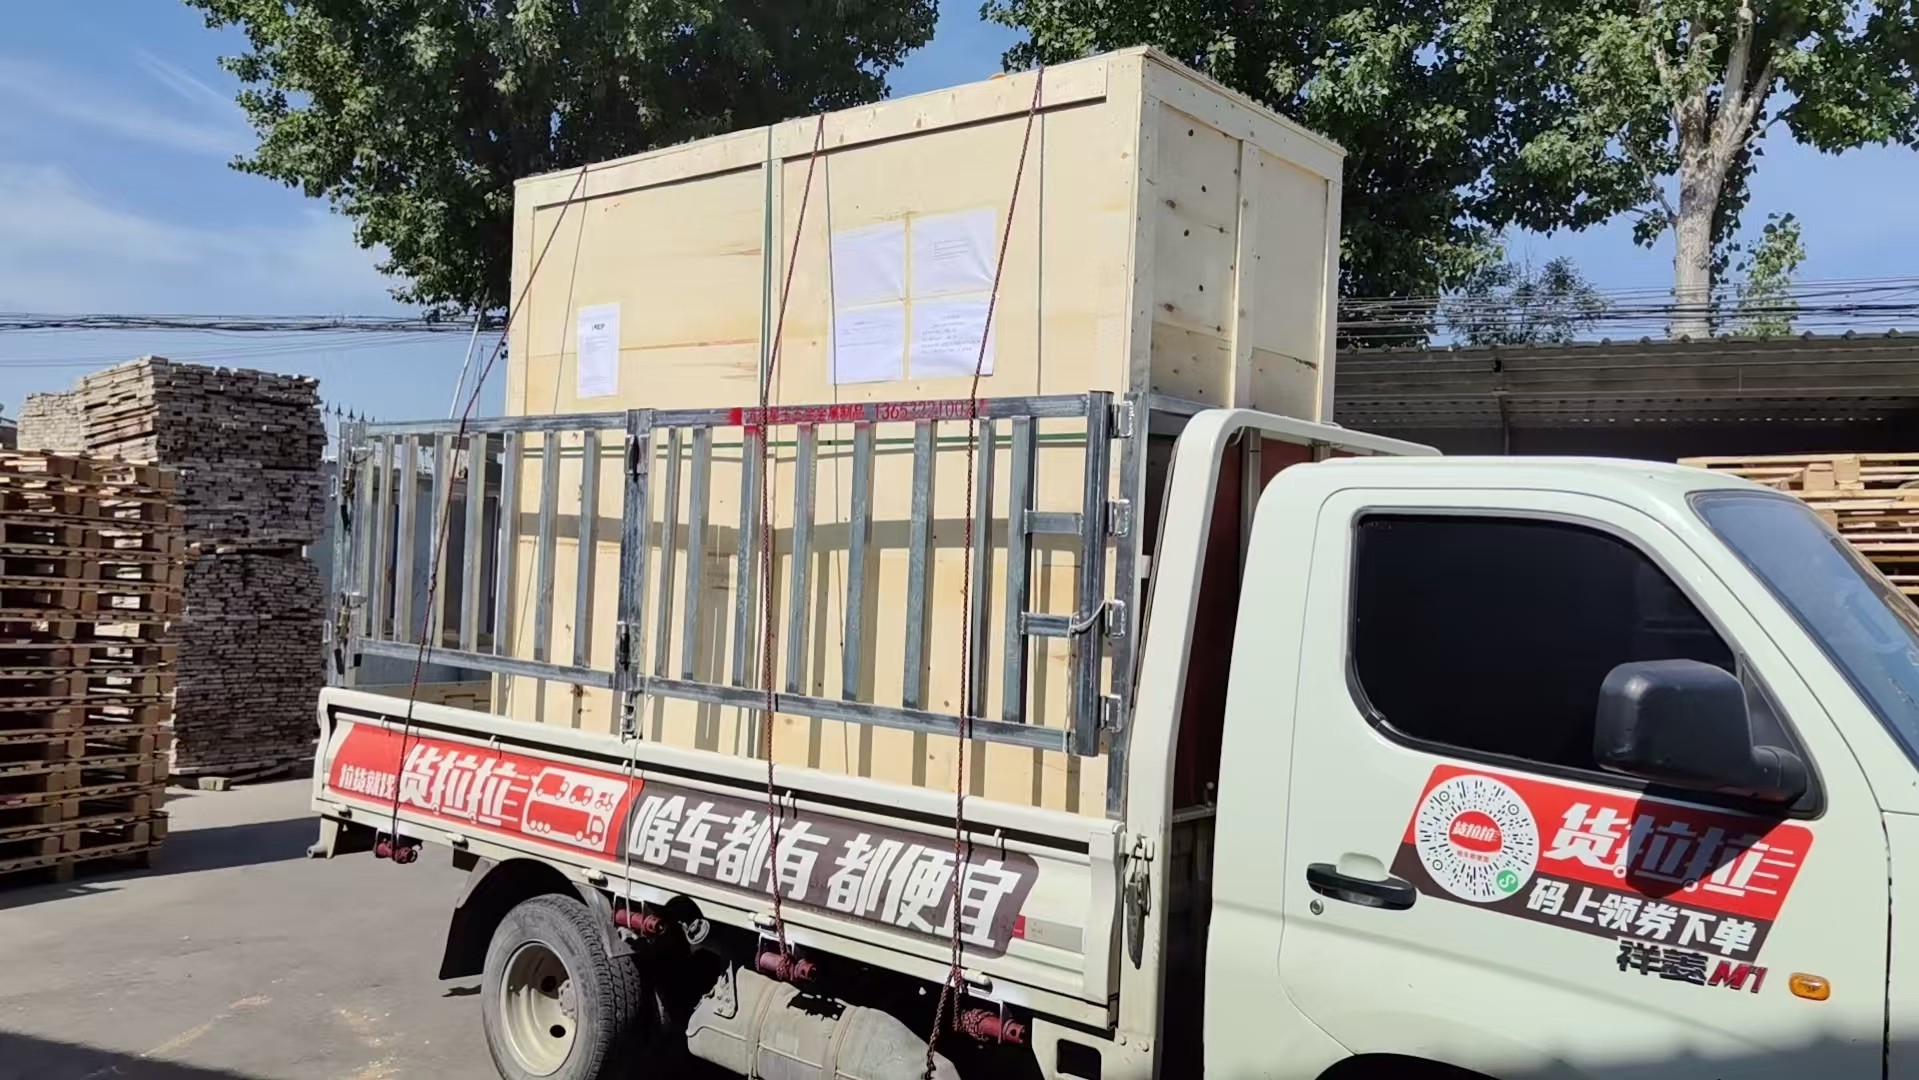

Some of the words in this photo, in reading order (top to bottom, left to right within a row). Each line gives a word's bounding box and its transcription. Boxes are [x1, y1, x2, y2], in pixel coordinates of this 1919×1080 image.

[399, 743, 519, 827] 货拉拉
[628, 795, 832, 901] 啥车都有
[826, 833, 1021, 948] 都便宜
[1543, 802, 1770, 897] 货拉拉
[1527, 876, 1758, 956] 码上领券下单
